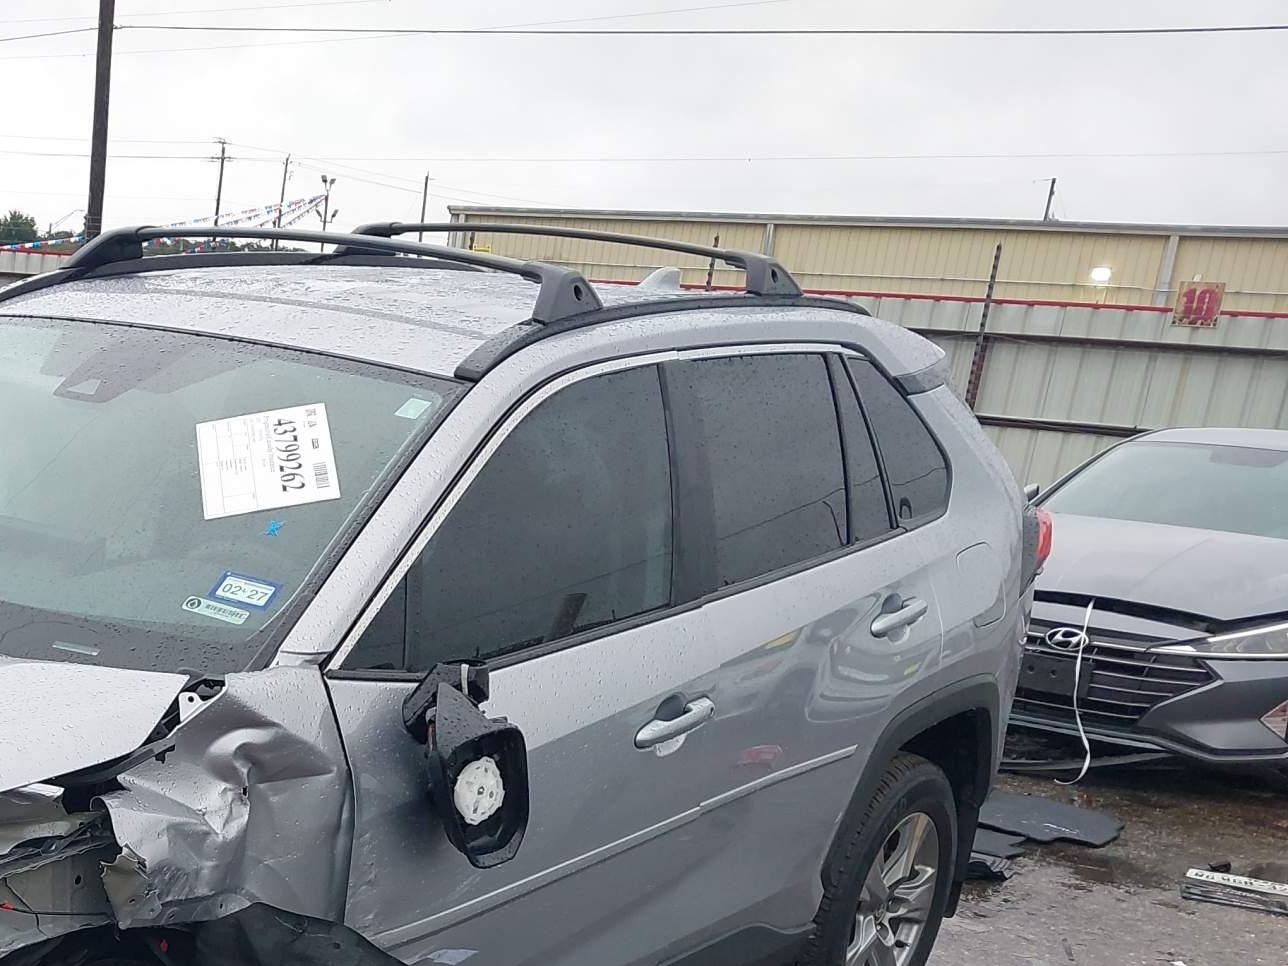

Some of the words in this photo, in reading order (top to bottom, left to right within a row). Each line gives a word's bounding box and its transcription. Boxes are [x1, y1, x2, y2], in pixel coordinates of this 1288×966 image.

[1182, 287, 1218, 322] 10
[273, 417, 306, 492] 43799262
[247, 589, 269, 601] 27
